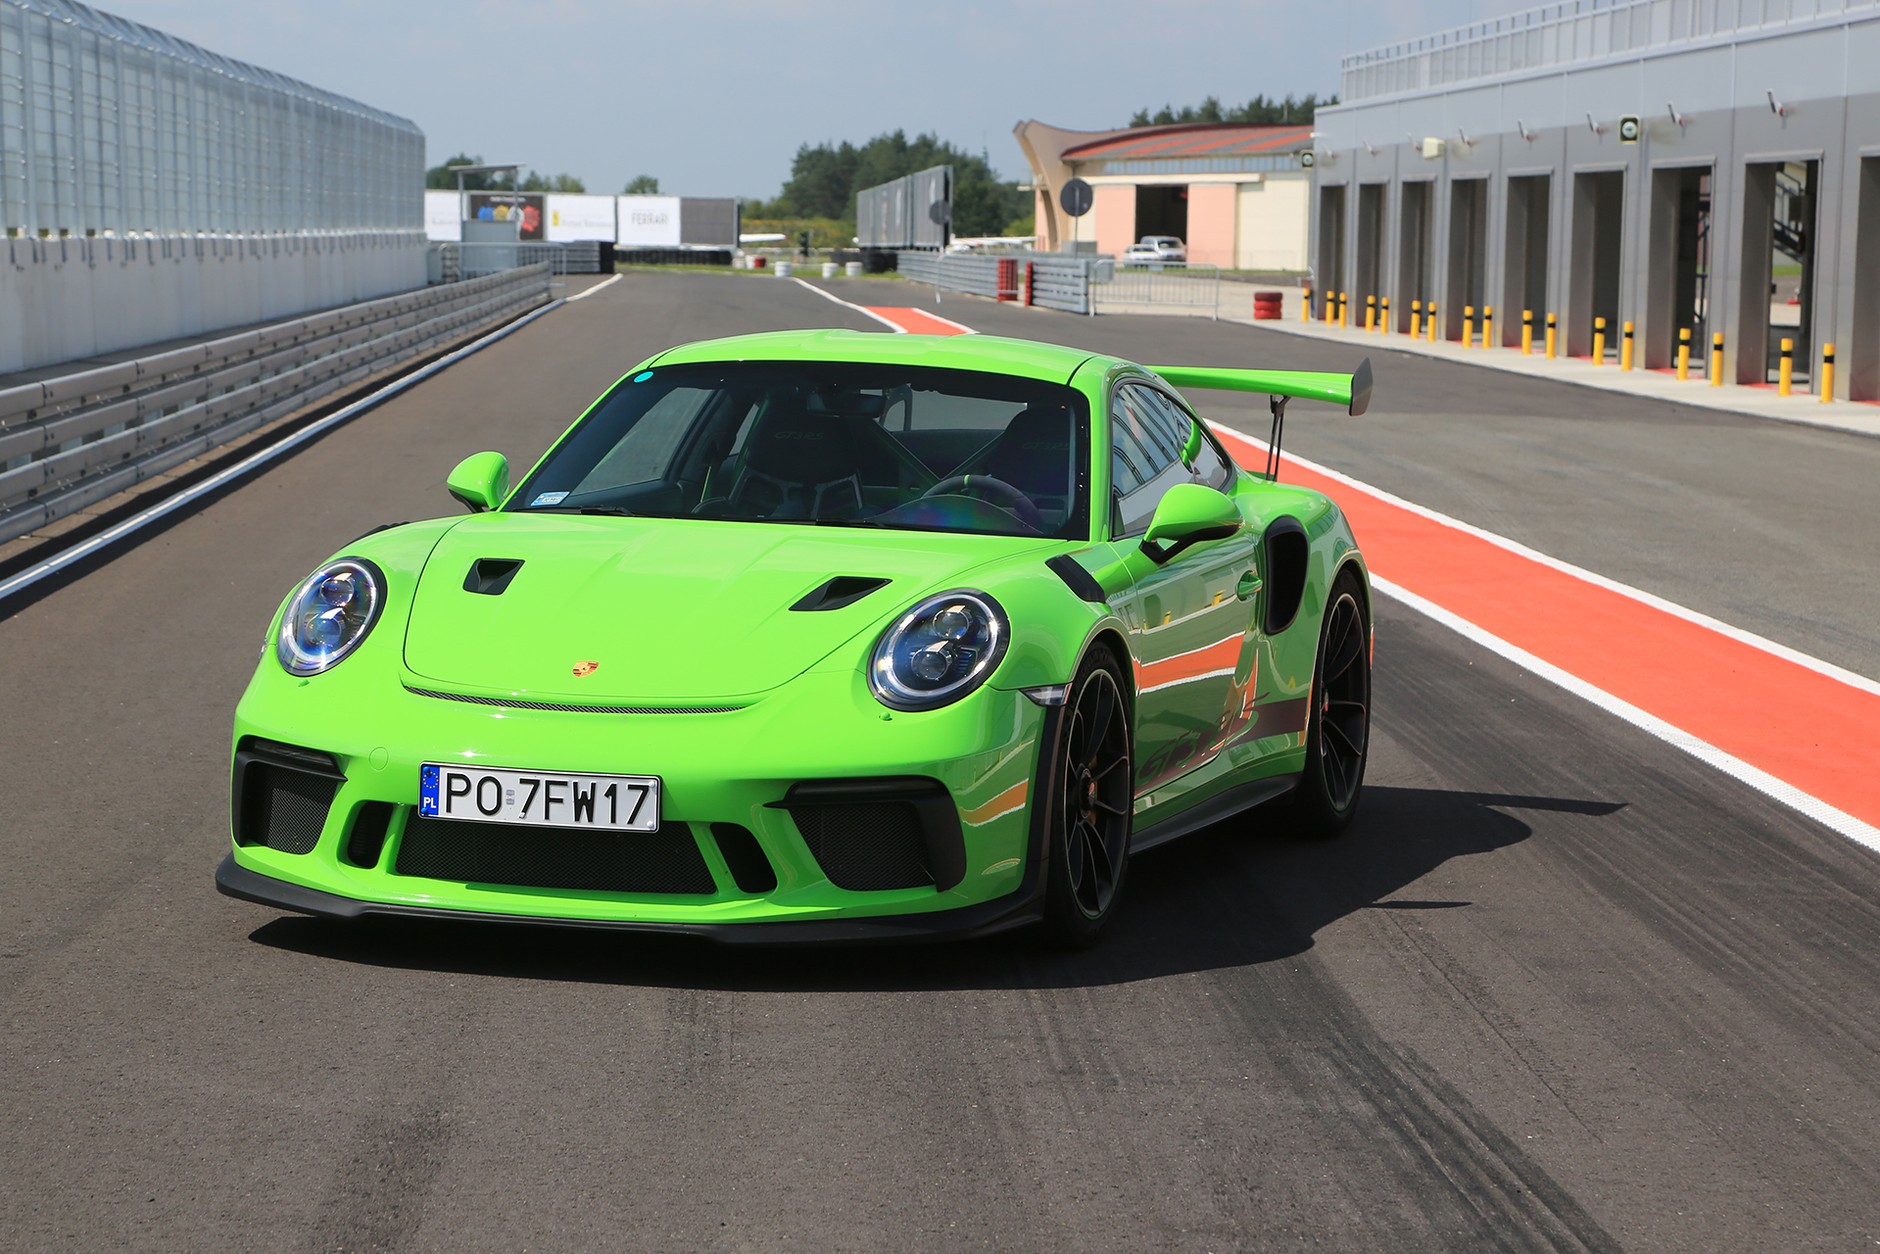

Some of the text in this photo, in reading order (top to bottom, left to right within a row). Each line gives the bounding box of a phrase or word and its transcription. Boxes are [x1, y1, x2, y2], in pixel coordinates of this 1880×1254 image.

[631, 212, 669, 225] FERRARI
[423, 796, 437, 809] PL
[446, 773, 650, 825] PO 7FW17
